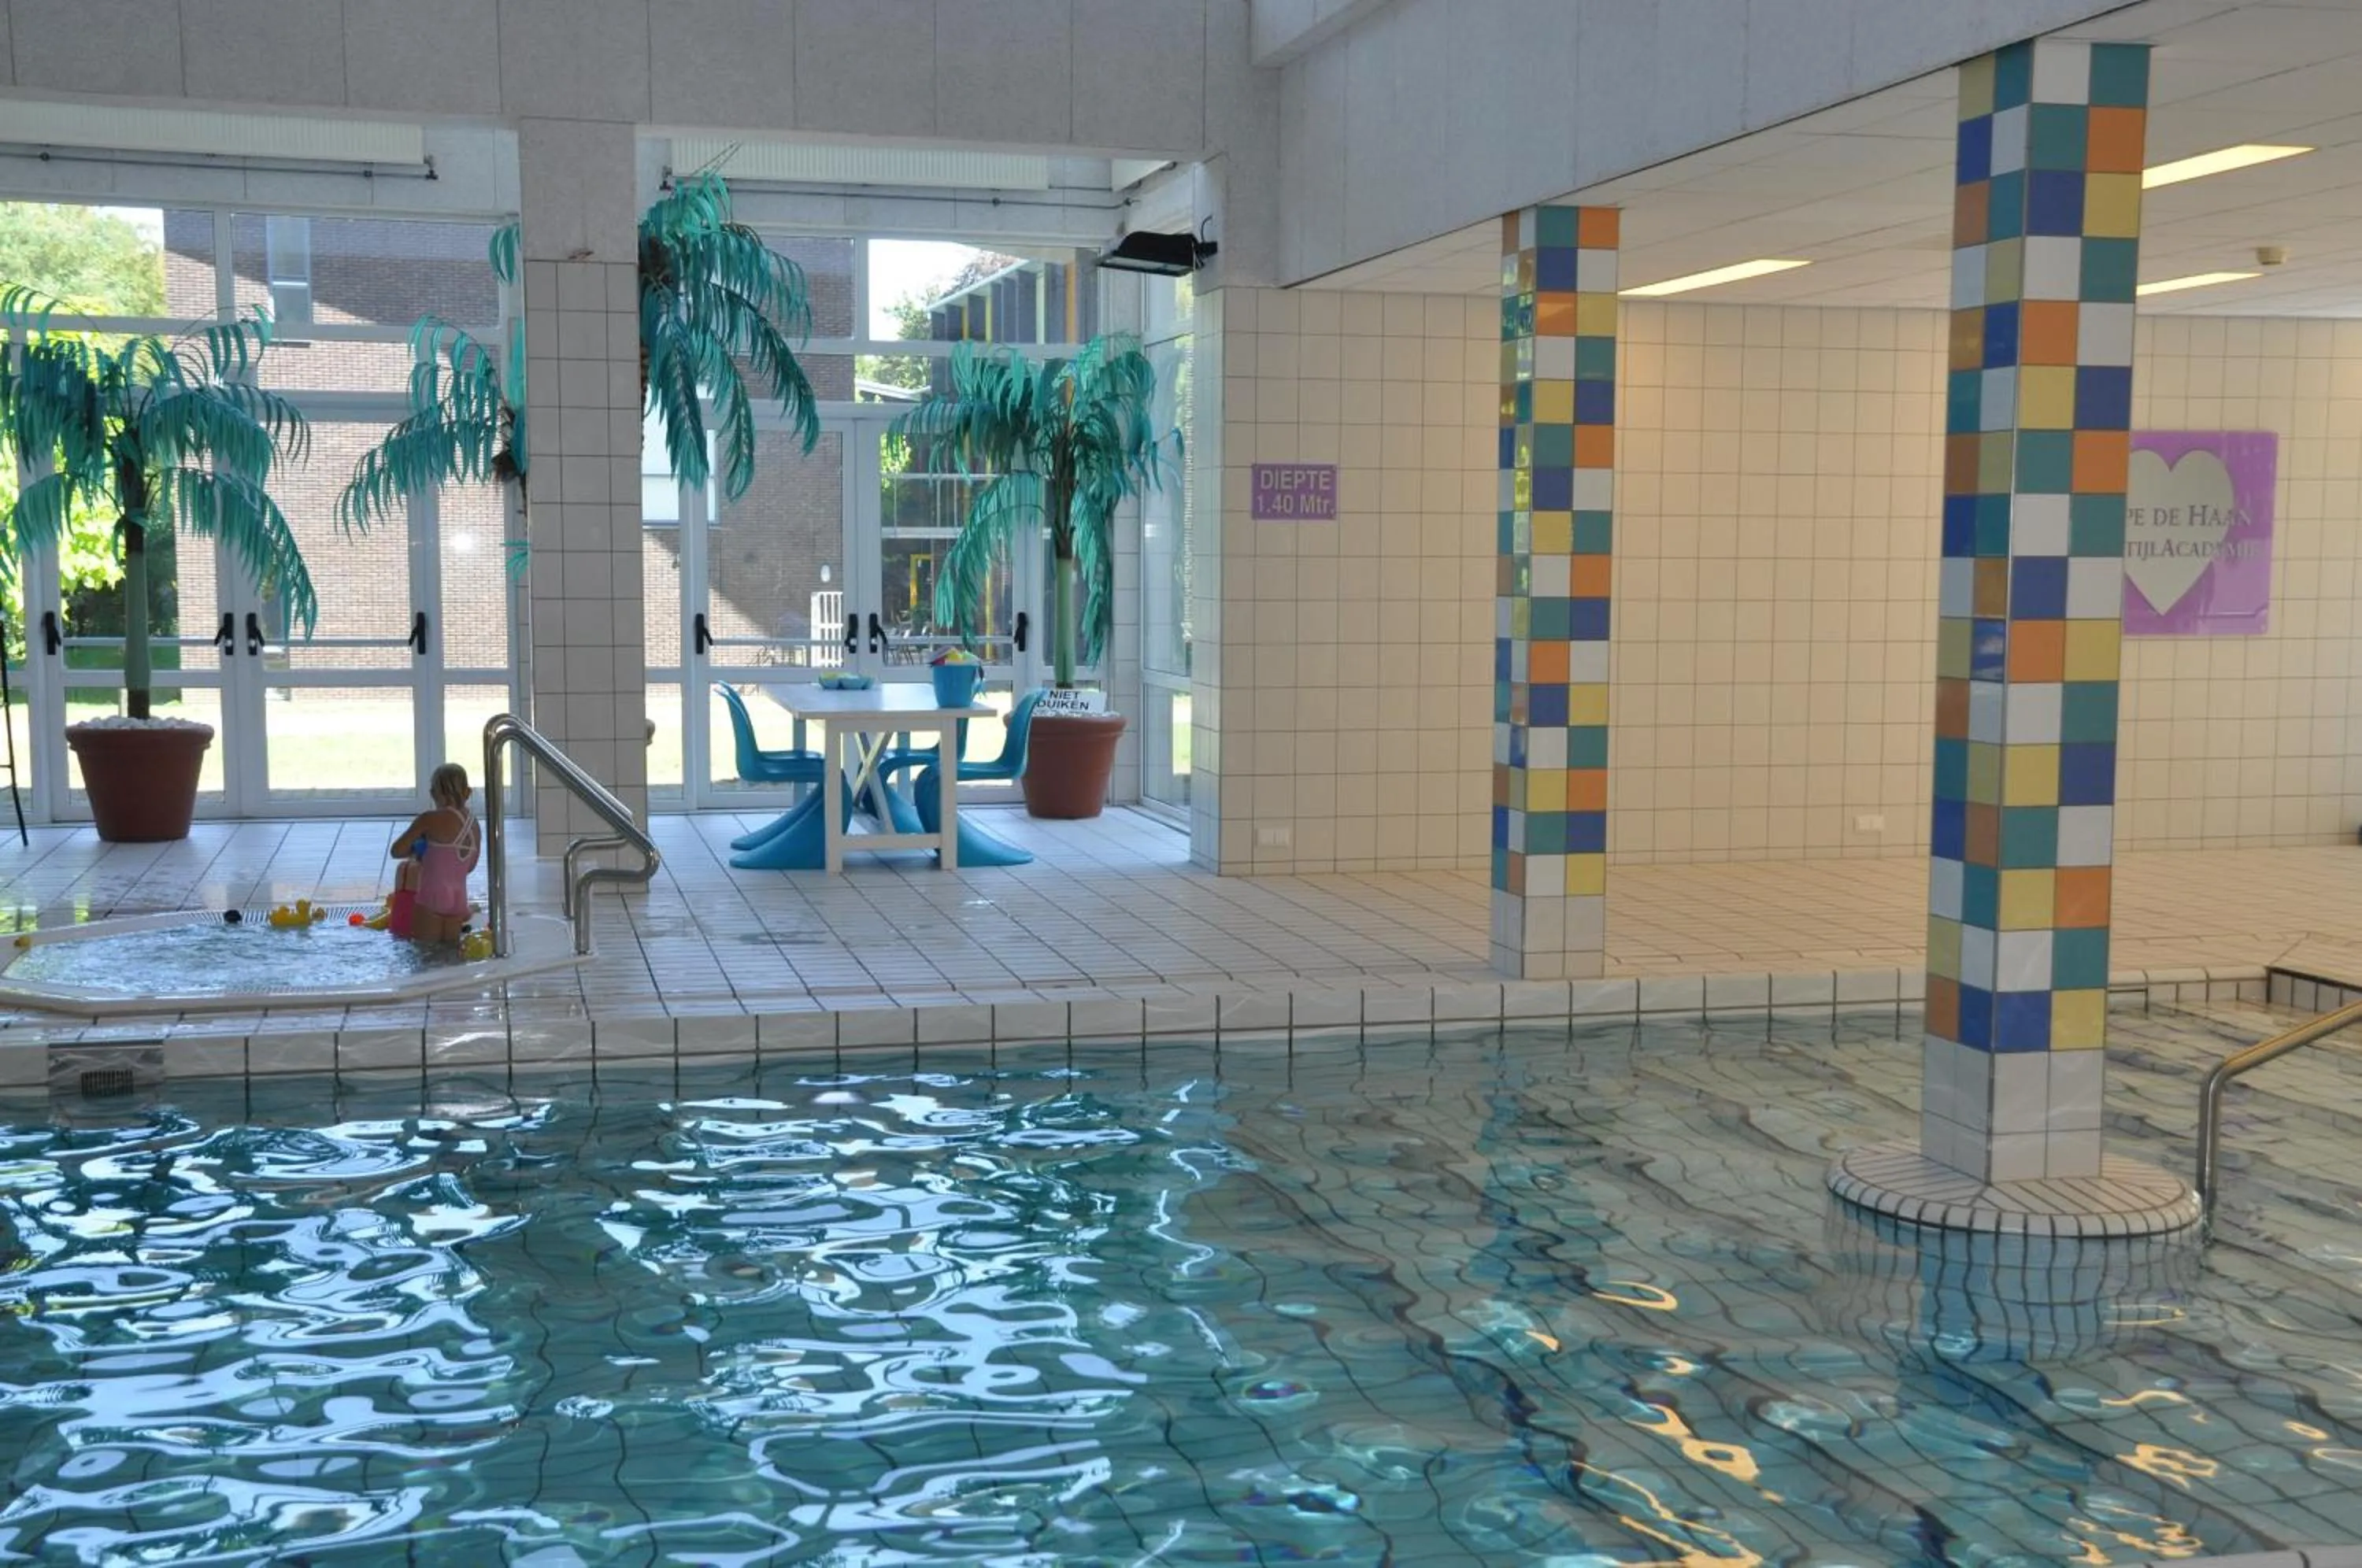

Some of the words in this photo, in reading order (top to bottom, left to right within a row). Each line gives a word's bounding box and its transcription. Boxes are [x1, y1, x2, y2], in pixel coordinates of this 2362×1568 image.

[1261, 471, 1331, 490] DIEPTE
[1257, 493, 1293, 513] 1.40
[1050, 690, 1079, 700] NIET
[1036, 701, 1089, 710] DUIKEN
